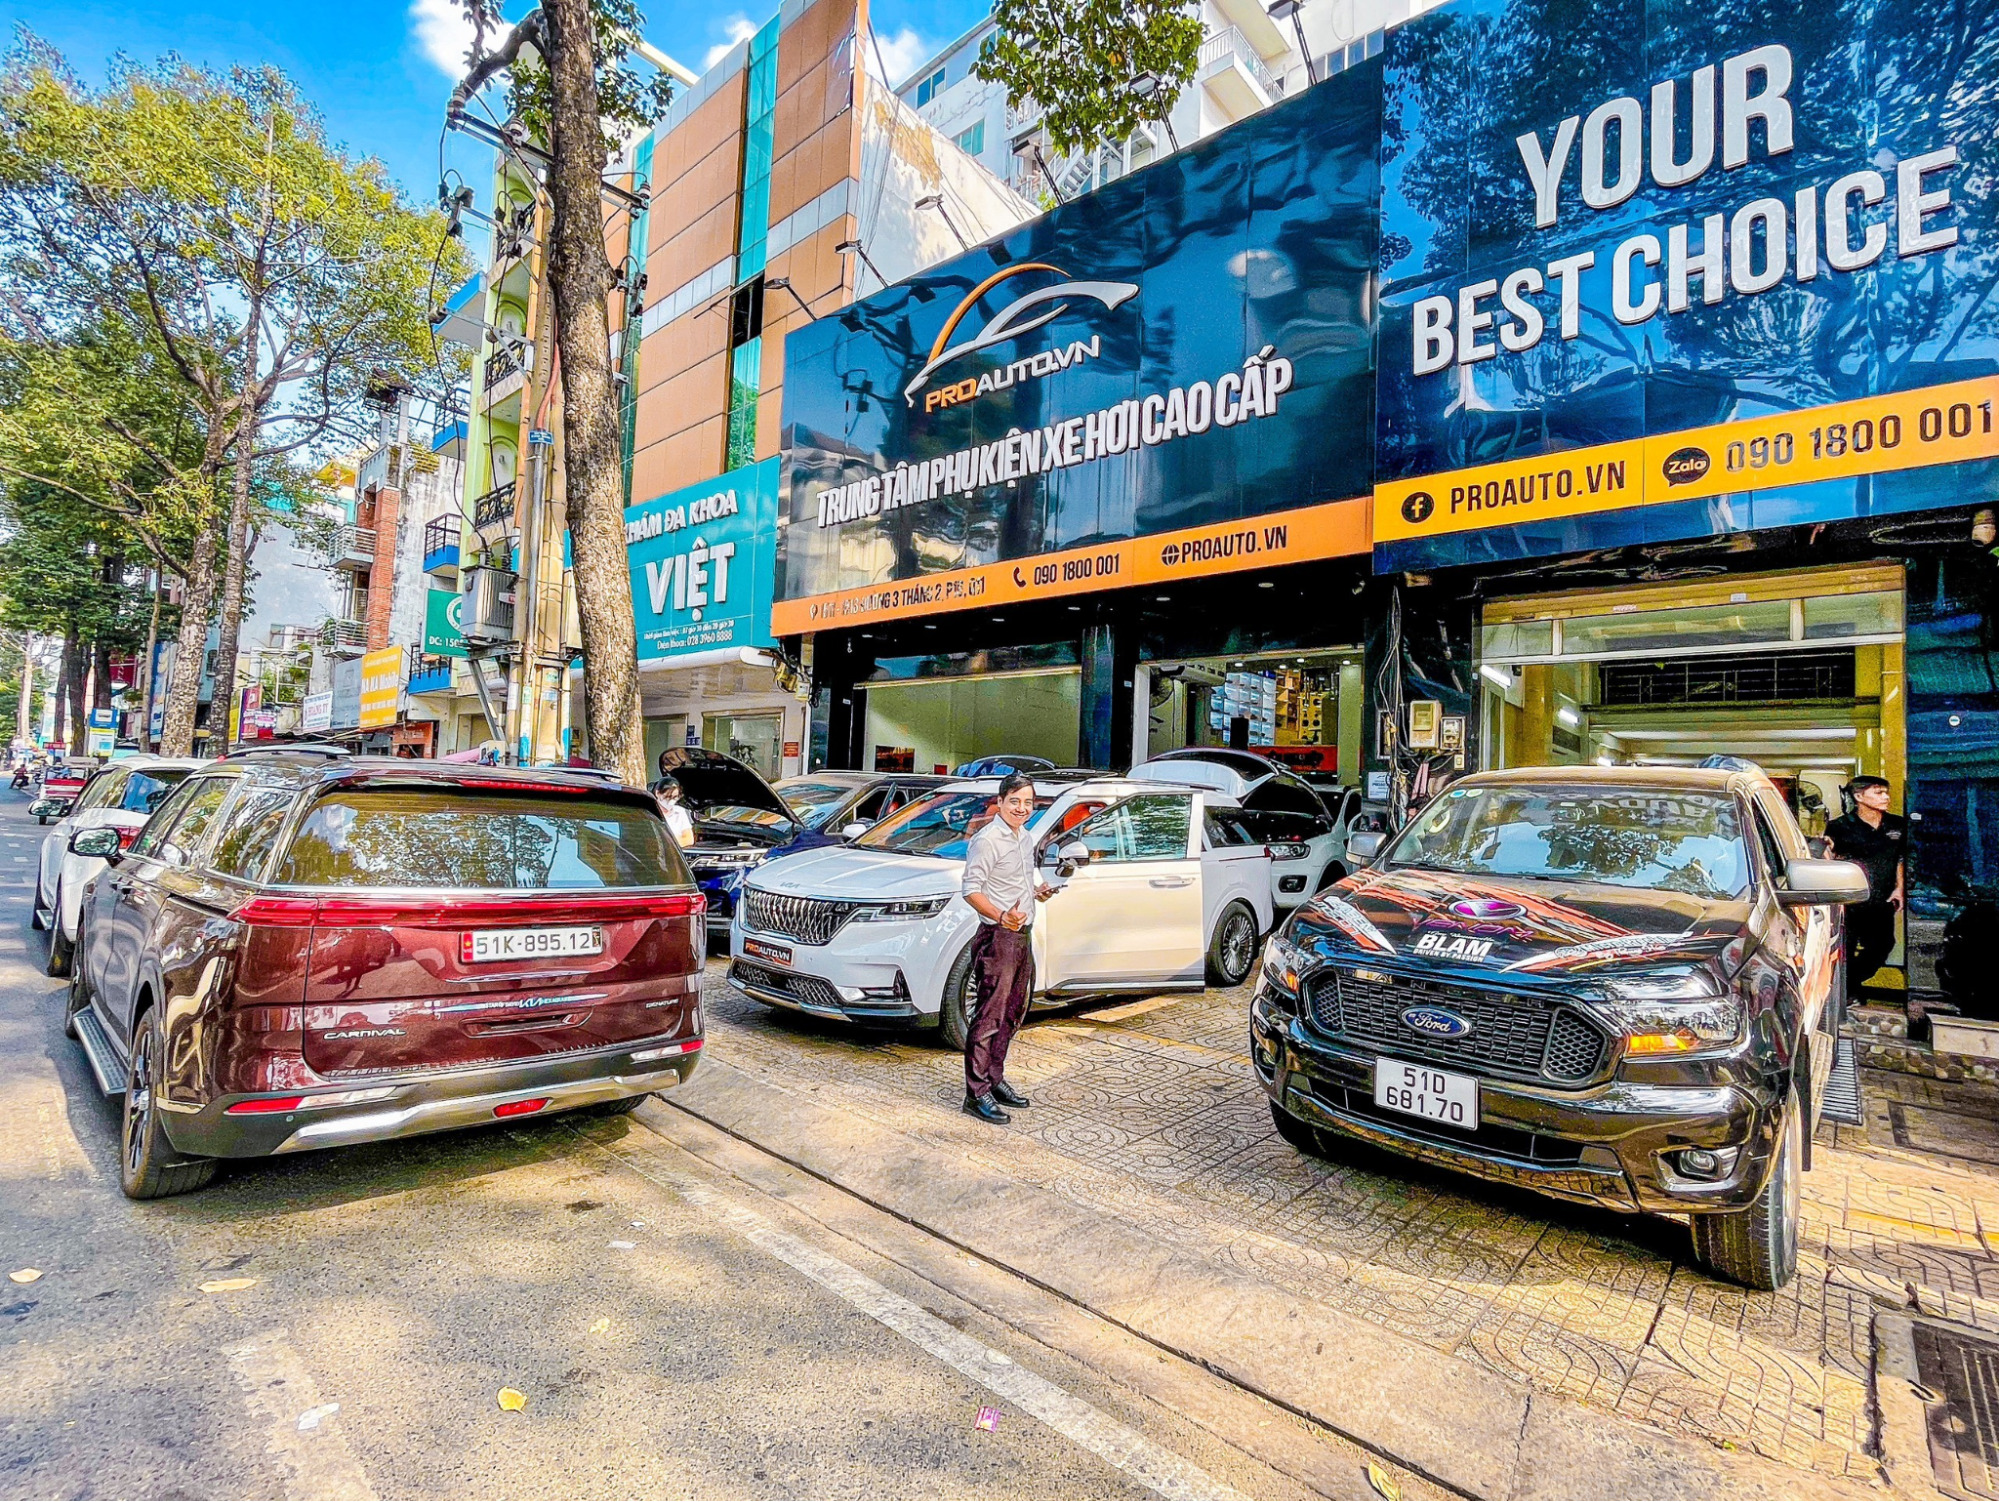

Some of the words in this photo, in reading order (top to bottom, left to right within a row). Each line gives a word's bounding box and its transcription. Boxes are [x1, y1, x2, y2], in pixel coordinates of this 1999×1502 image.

[1516, 43, 1795, 229] YOUR
[1412, 252, 1595, 376] BEST
[1611, 145, 1960, 326] CHOICE
[924, 334, 1102, 412] PROAUTO.VN
[816, 477, 884, 529] TRUNG
[880, 460, 933, 513] TÂM
[929, 447, 979, 500] PHỤ
[976, 427, 1042, 490] KIỆN
[1040, 416, 1085, 473] XE
[1083, 400, 1141, 461] HƠI
[1138, 380, 1214, 446] CAO
[1212, 343, 1294, 428] CẤP
[1449, 459, 1627, 515] PROAUTO.VN
[1668, 458, 1707, 474] Zalo
[1725, 431, 1793, 473] 090
[1808, 413, 1903, 460] 1800
[1918, 401, 1993, 443] 001
[663, 504, 687, 533] ĐA
[688, 488, 739, 526] KHOA
[1034, 563, 1058, 586] 090
[1062, 557, 1092, 582] 1800
[1096, 553, 1121, 576] 001
[1181, 525, 1288, 564] PROAUTO.VN
[645, 536, 735, 622] VIỆT
[892, 589, 900, 609] 3
[901, 583, 933, 607] THÁNG
[687, 635, 699, 646] 028
[475, 930, 591, 955] 51K-895.12
[745, 941, 790, 961] PROAUTO.VN
[1416, 932, 1494, 957] BLAM
[323, 1028, 407, 1041] CARNIVAL
[1413, 1012, 1452, 1033] Ford
[1403, 1066, 1446, 1095] 51D
[1386, 1085, 1464, 1123] 681.70
